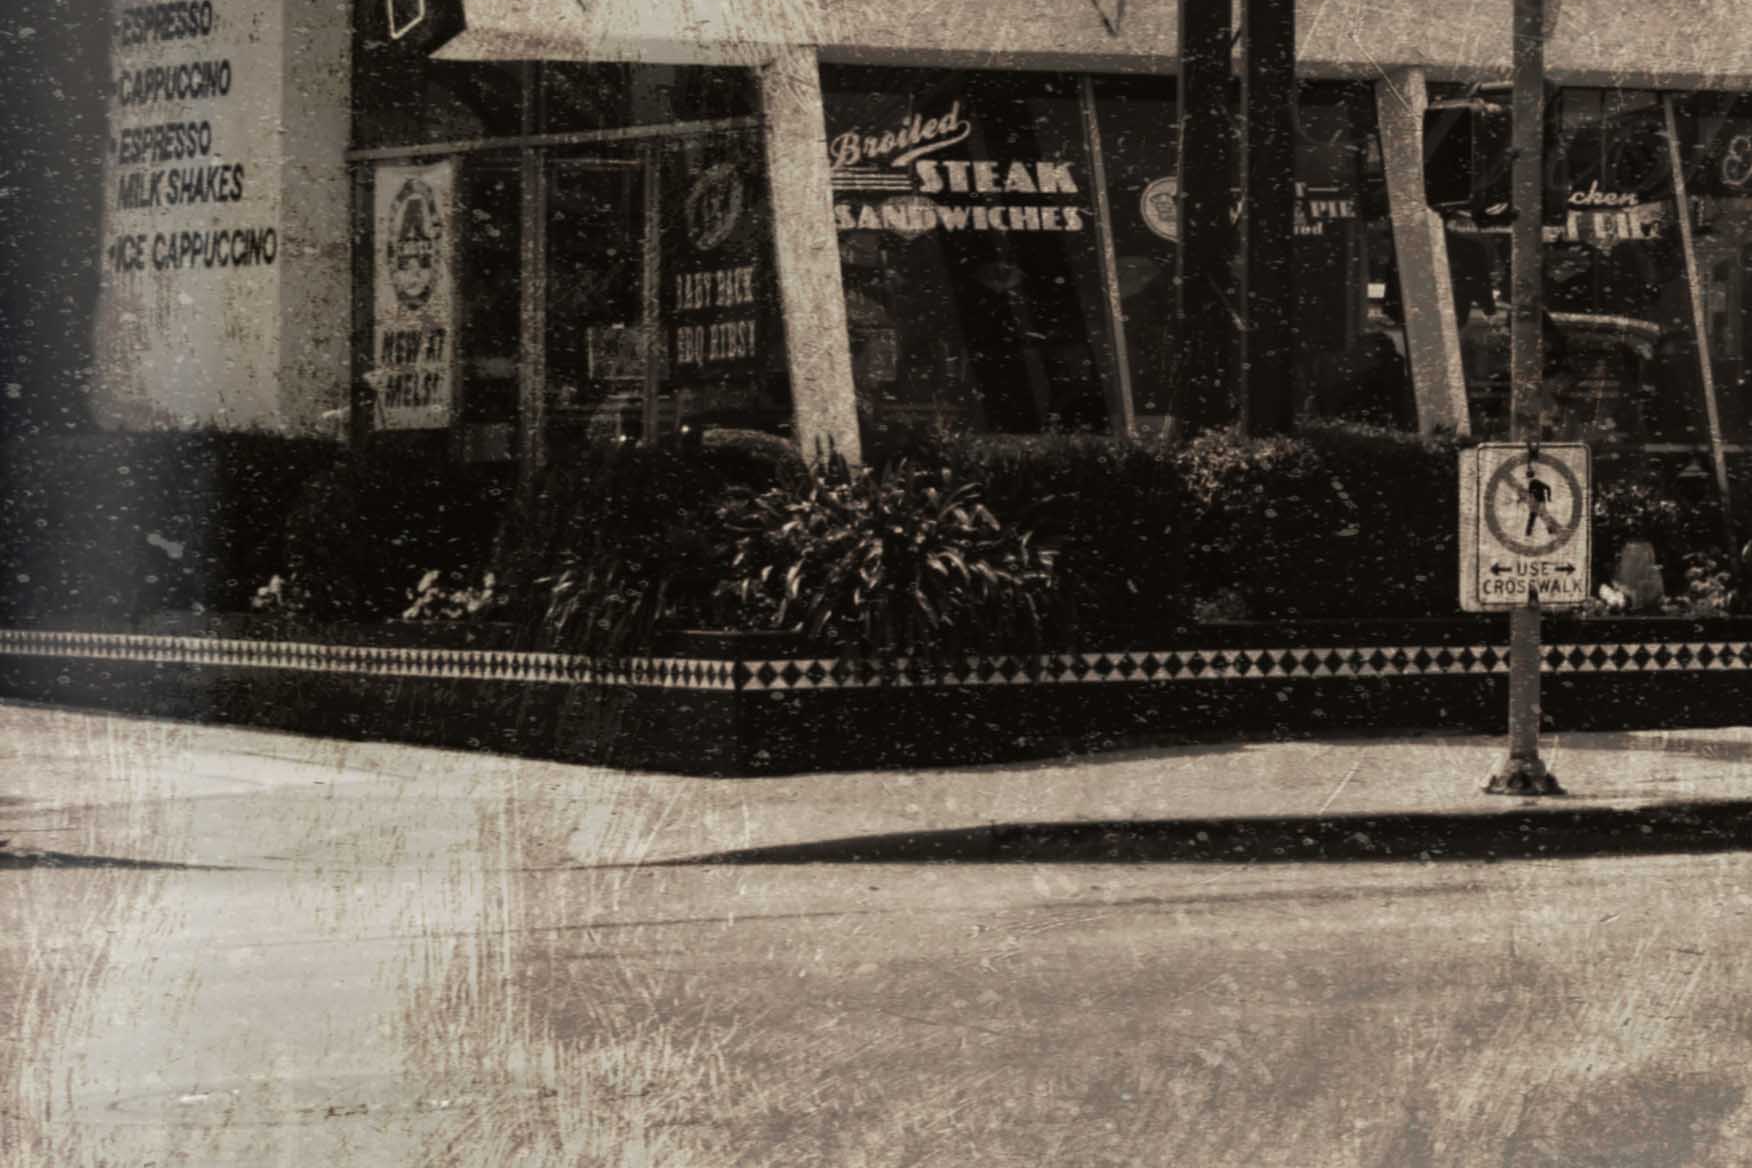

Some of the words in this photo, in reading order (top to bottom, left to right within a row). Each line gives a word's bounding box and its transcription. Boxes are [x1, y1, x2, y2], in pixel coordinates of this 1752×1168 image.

[121, 0, 213, 47] ESPRESSO
[118, 59, 232, 107] CAPPUCCINO
[119, 121, 212, 165] ESPRESSO
[830, 100, 970, 170] Broiled
[116, 167, 165, 210] MILK
[166, 162, 245, 206] SHAKES
[915, 160, 1079, 193] STEAK
[832, 205, 1084, 231] SANDWICHES
[113, 234, 146, 273] ICE
[152, 227, 278, 272] CAPPUCCINO
[1516, 561, 1550, 577] USE
